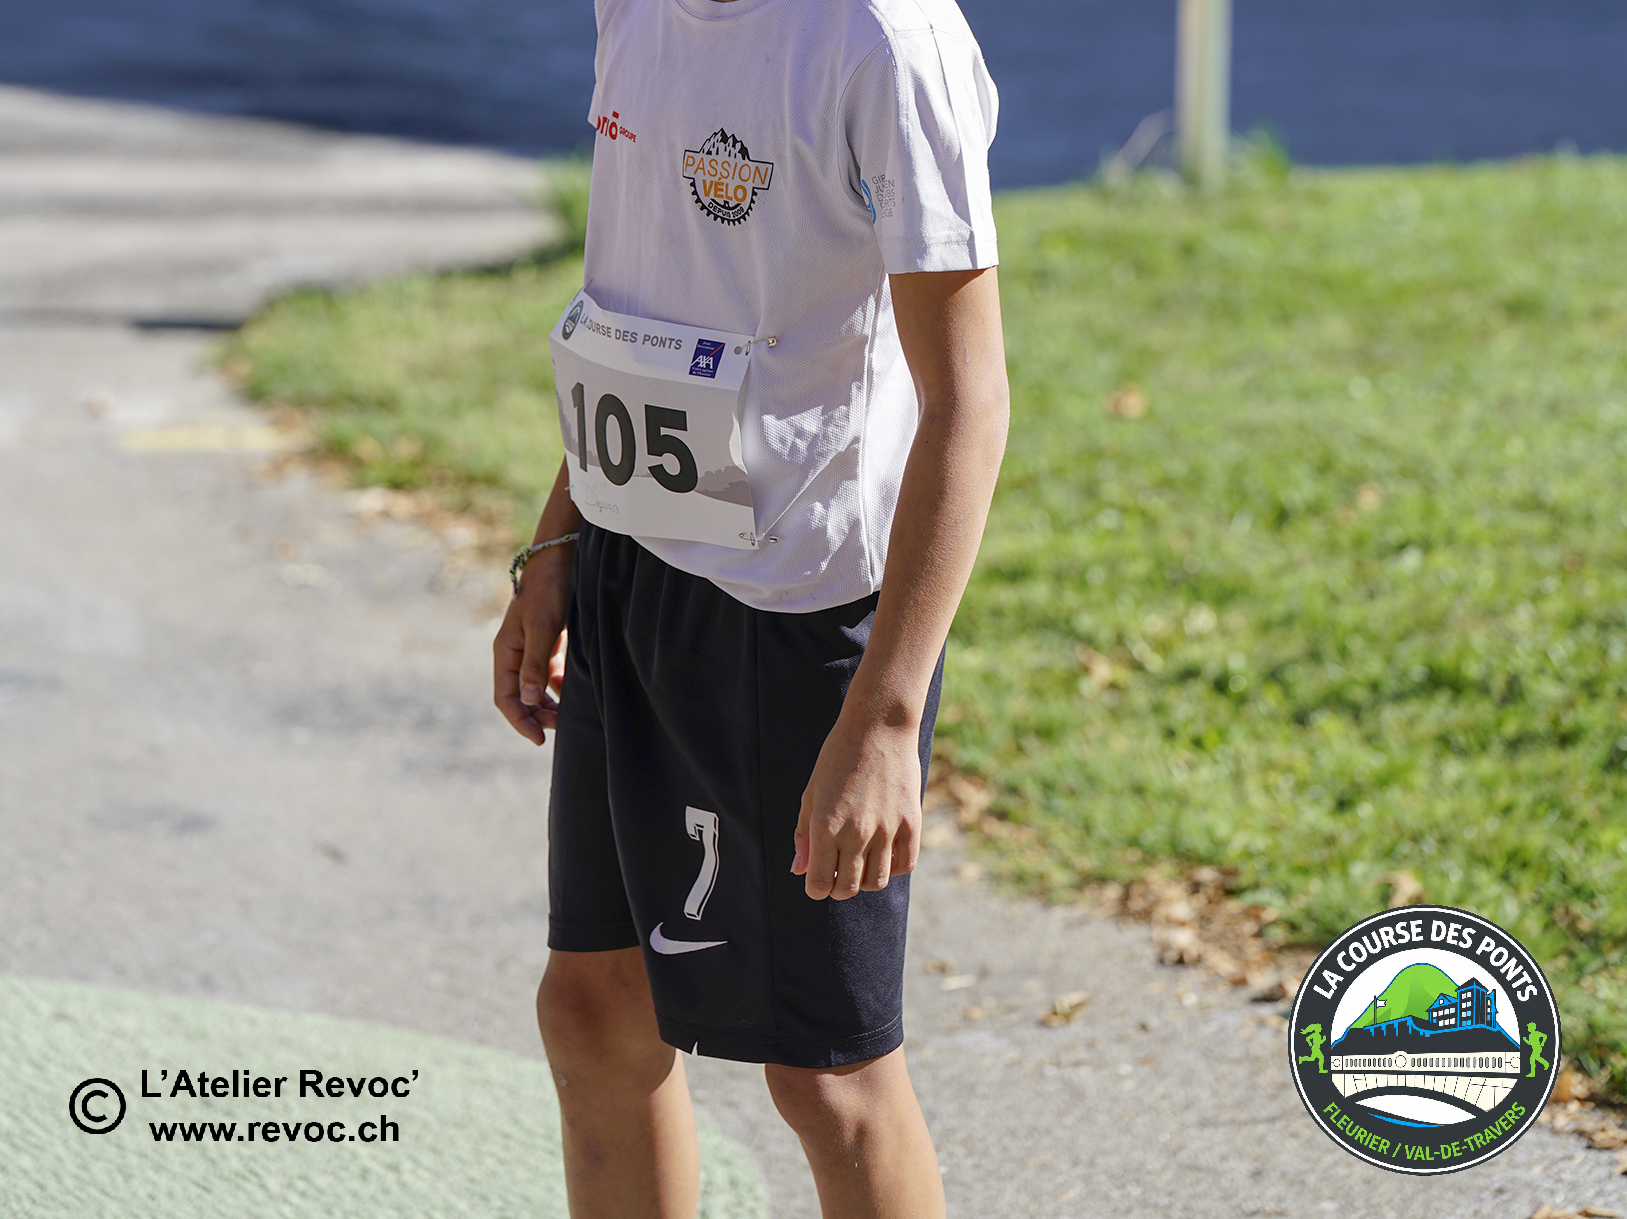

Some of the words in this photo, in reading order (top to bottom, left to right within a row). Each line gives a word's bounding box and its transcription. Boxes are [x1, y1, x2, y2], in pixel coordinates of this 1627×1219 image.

[684, 155, 769, 185] PASSION
[702, 177, 747, 203] VÉLO
[614, 328, 638, 343] DES
[642, 334, 683, 350] PONTS
[691, 355, 714, 369] AXA
[571, 381, 699, 494] 105
[683, 805, 720, 921] 7
